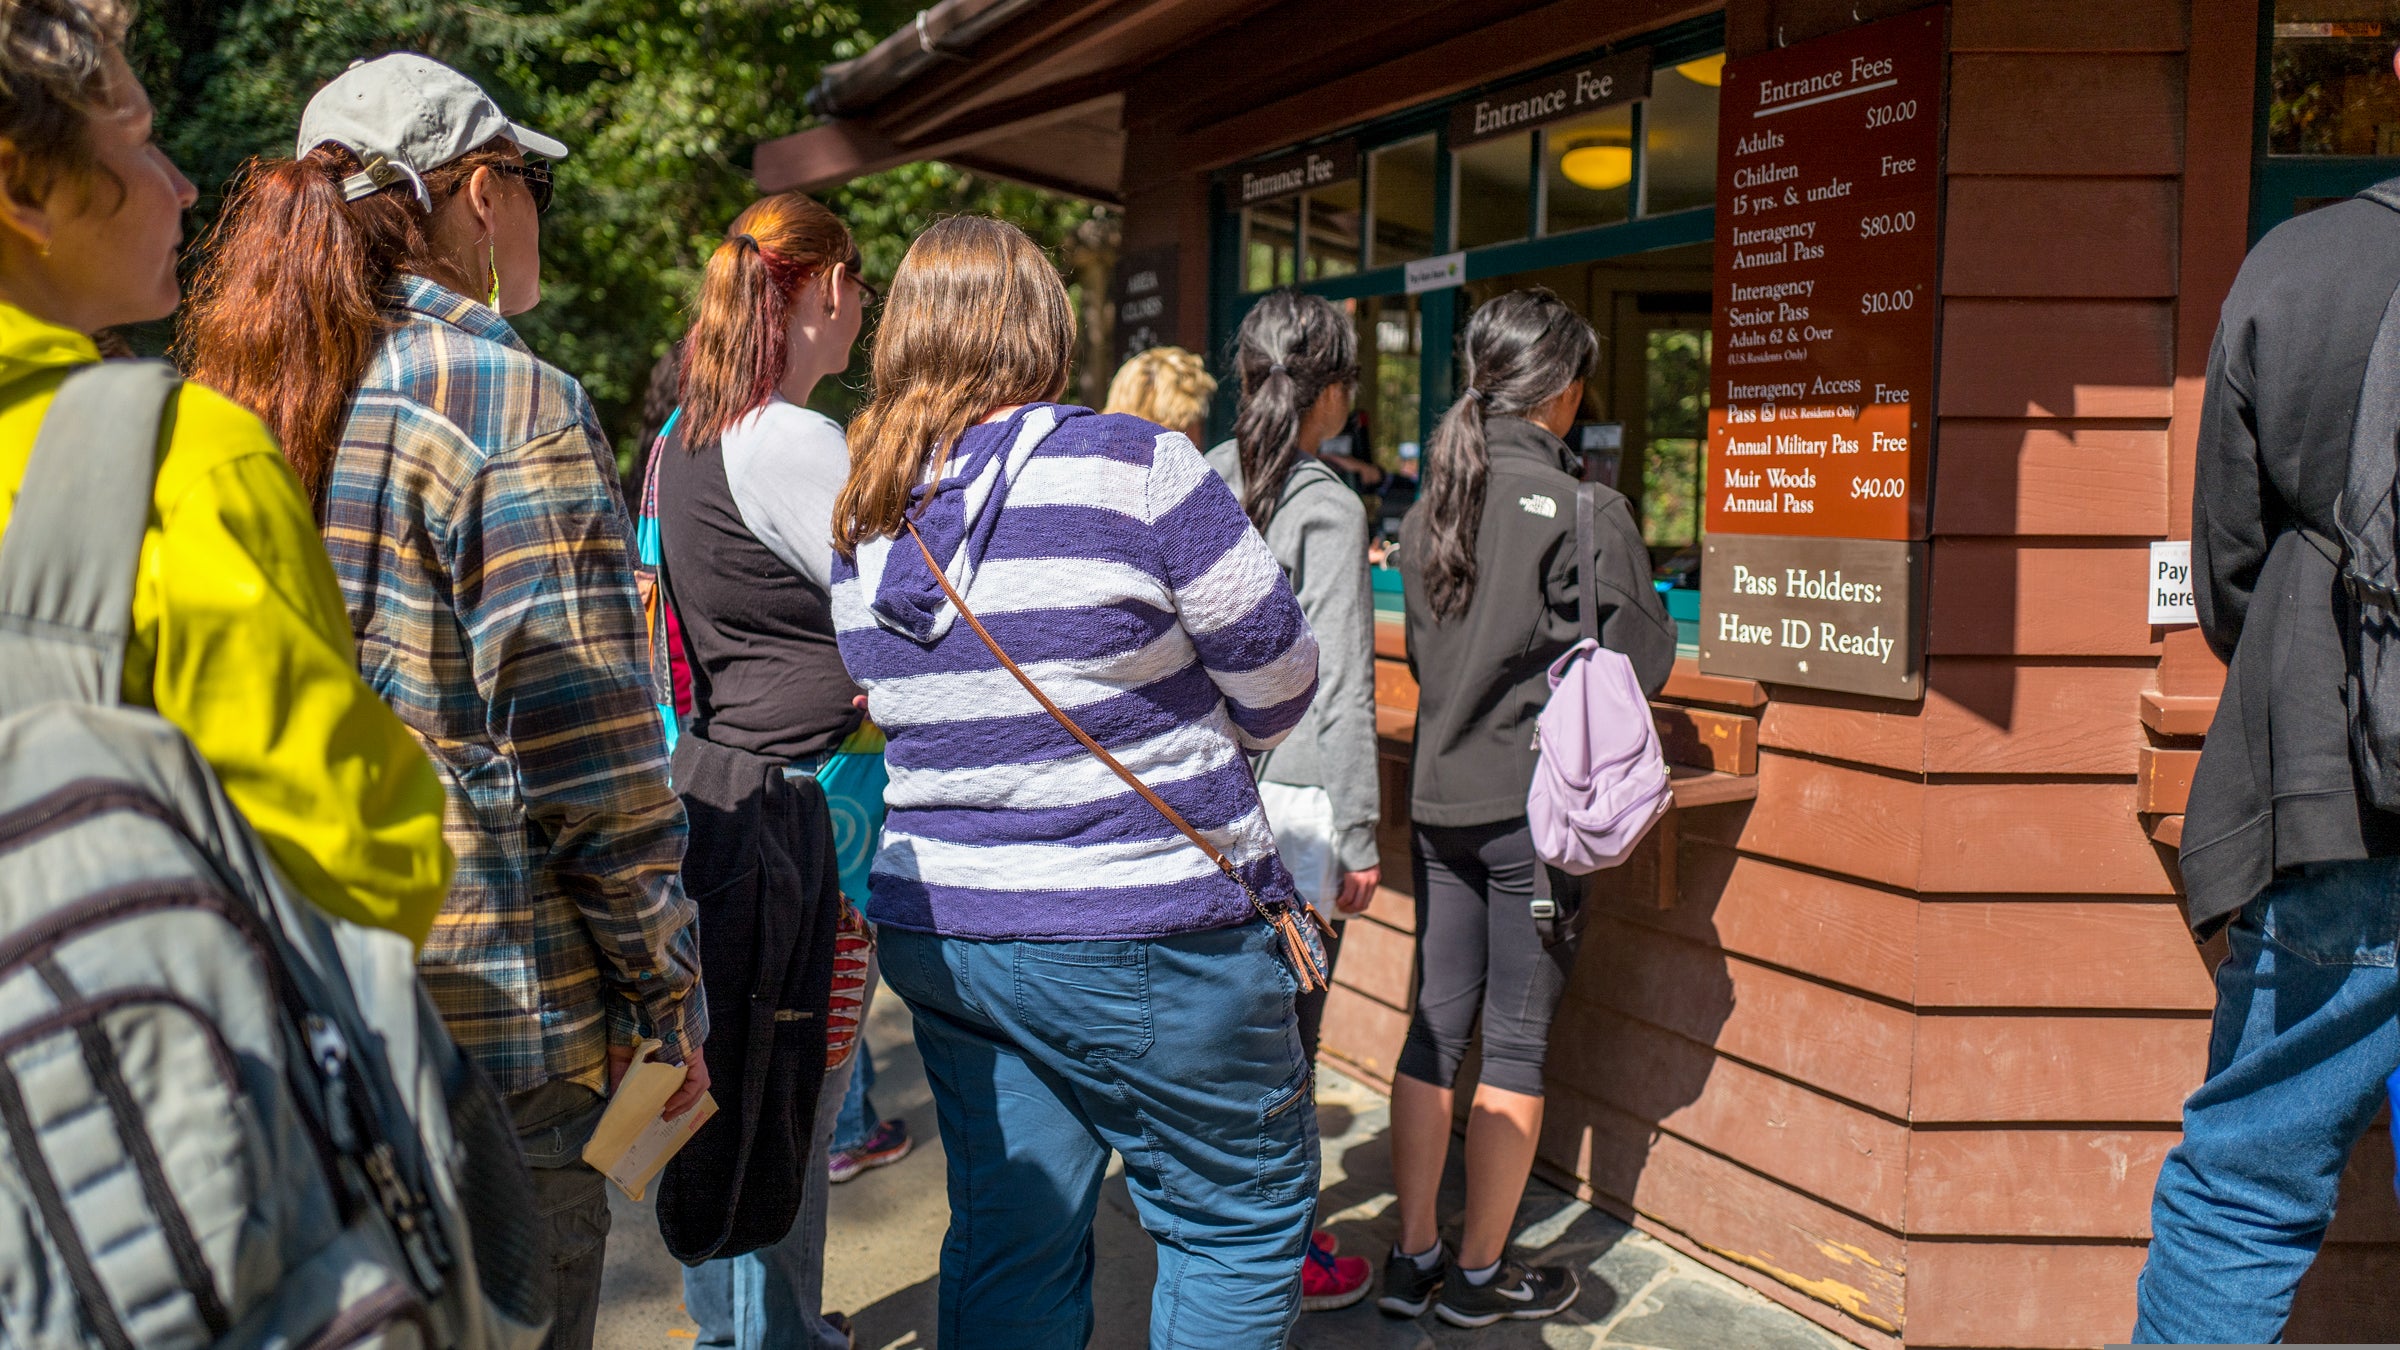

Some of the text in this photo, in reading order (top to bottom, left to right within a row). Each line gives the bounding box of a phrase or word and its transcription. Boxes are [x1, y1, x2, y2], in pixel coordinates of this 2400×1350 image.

[1759, 56, 1893, 105] Entrance Fees
[1473, 69, 1614, 135] Entrance Fee
[1865, 99, 1917, 129] $10.00
[1735, 129, 1785, 156] Adults
[1307, 154, 1334, 183] Fee
[1733, 162, 1799, 189] Children
[1881, 155, 1917, 177] Free
[1732, 176, 1853, 216] 15 yrs. & under
[1732, 221, 1816, 247] Interagency
[1860, 210, 1916, 239] $80.00
[1731, 241, 1825, 270] Annual Pass
[1731, 279, 1815, 303] Interagency
[1861, 289, 1914, 316] $10.00
[1729, 302, 1810, 328] Senior Pass
[1729, 325, 1834, 348] Adults 62 & Over
[1784, 347, 1808, 361] Only)
[1727, 375, 1861, 401] Interagency Access
[1874, 383, 1909, 404] Free
[1727, 404, 1757, 424] Pass
[1801, 406, 1835, 419] Residents
[1836, 404, 1860, 420] Only)
[1725, 434, 1860, 458] Annual Military Pass
[1871, 431, 1908, 452] Free
[1725, 467, 1817, 488] Muir Woods
[1850, 477, 1906, 500] $40.00
[1723, 493, 1815, 514] Annual Pass
[1733, 565, 1882, 604] Pass Holders:
[2158, 561, 2188, 585] Pay
[2157, 588, 2194, 607] here
[1718, 612, 1895, 664] Have ID Ready
